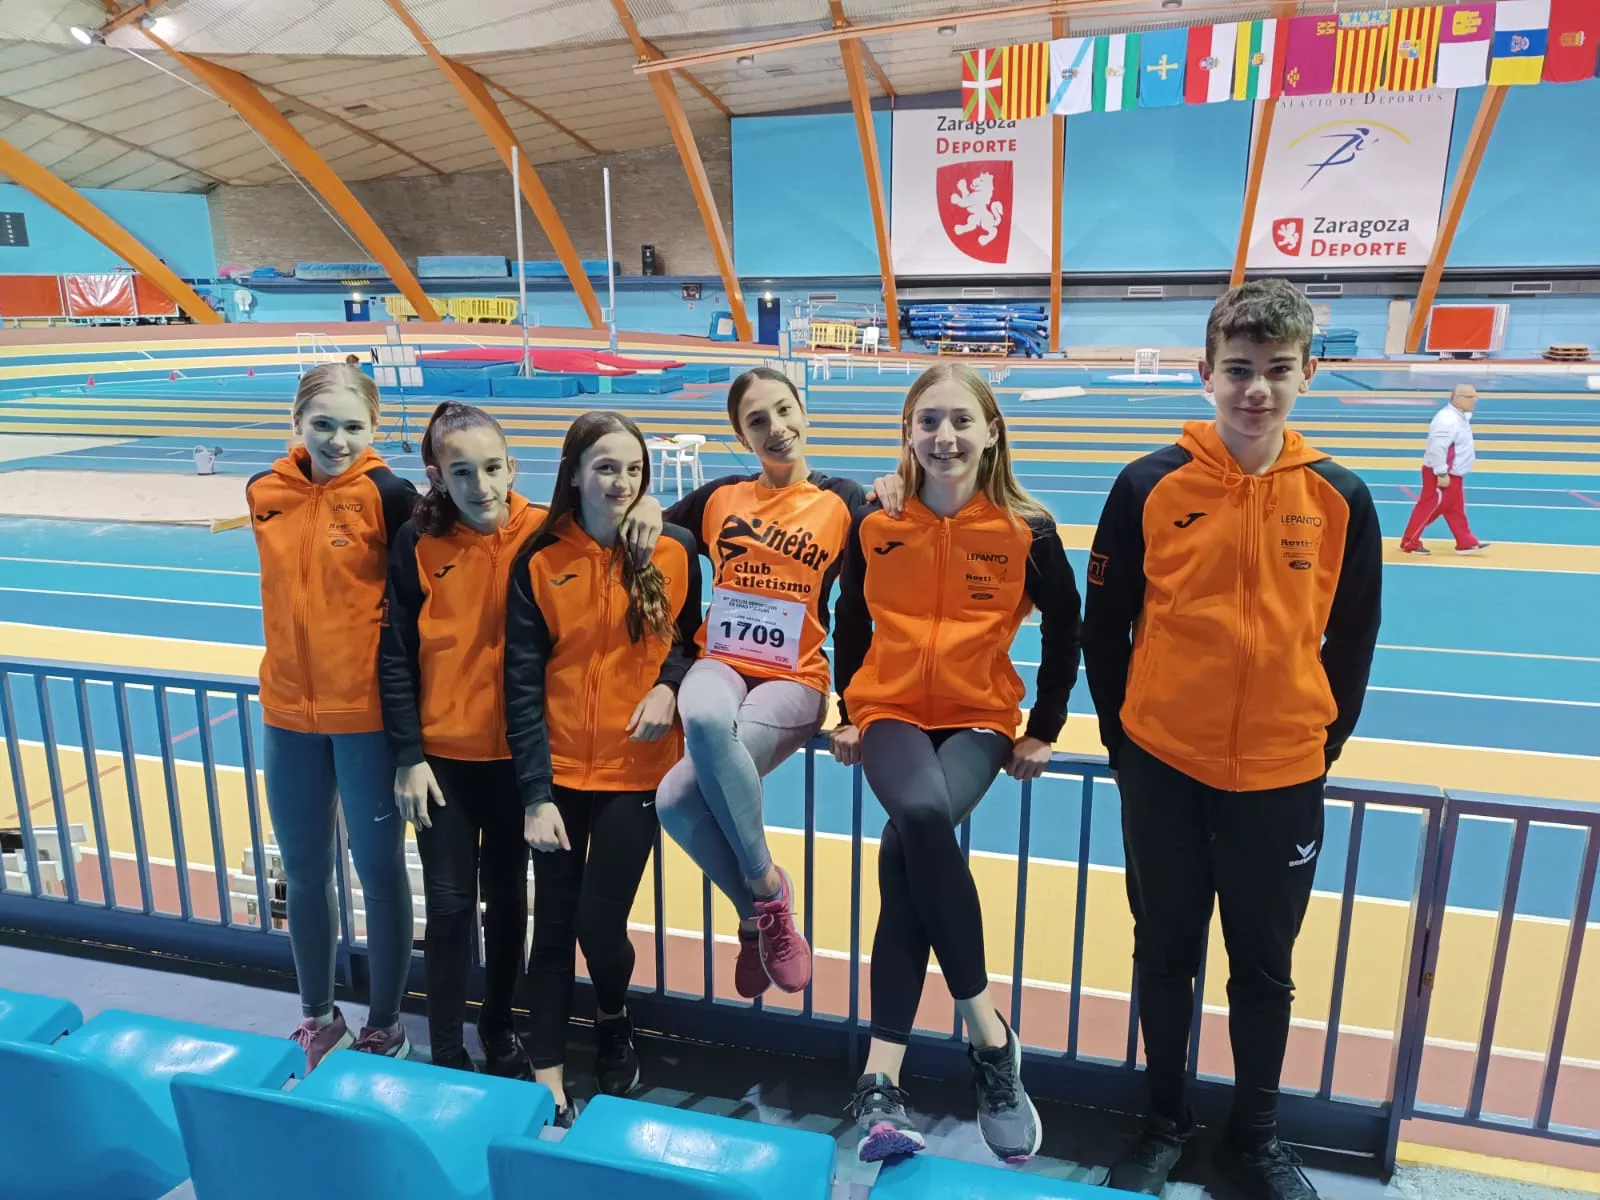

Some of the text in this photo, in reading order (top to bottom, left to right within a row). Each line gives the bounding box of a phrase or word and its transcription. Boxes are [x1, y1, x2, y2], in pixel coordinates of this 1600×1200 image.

[1281, 99, 1332, 108] ALACIO
[936, 116, 1016, 135] Zaragoza
[936, 138, 1017, 154] DEPORTE
[1312, 216, 1409, 238] Zaragoza
[1310, 239, 1406, 257] DEPORTE
[1281, 514, 1322, 527] LEPANTO
[966, 552, 1008, 565] LEPANTO
[734, 561, 771, 576] club
[735, 575, 811, 593] atletismo
[720, 621, 785, 648] 1709
